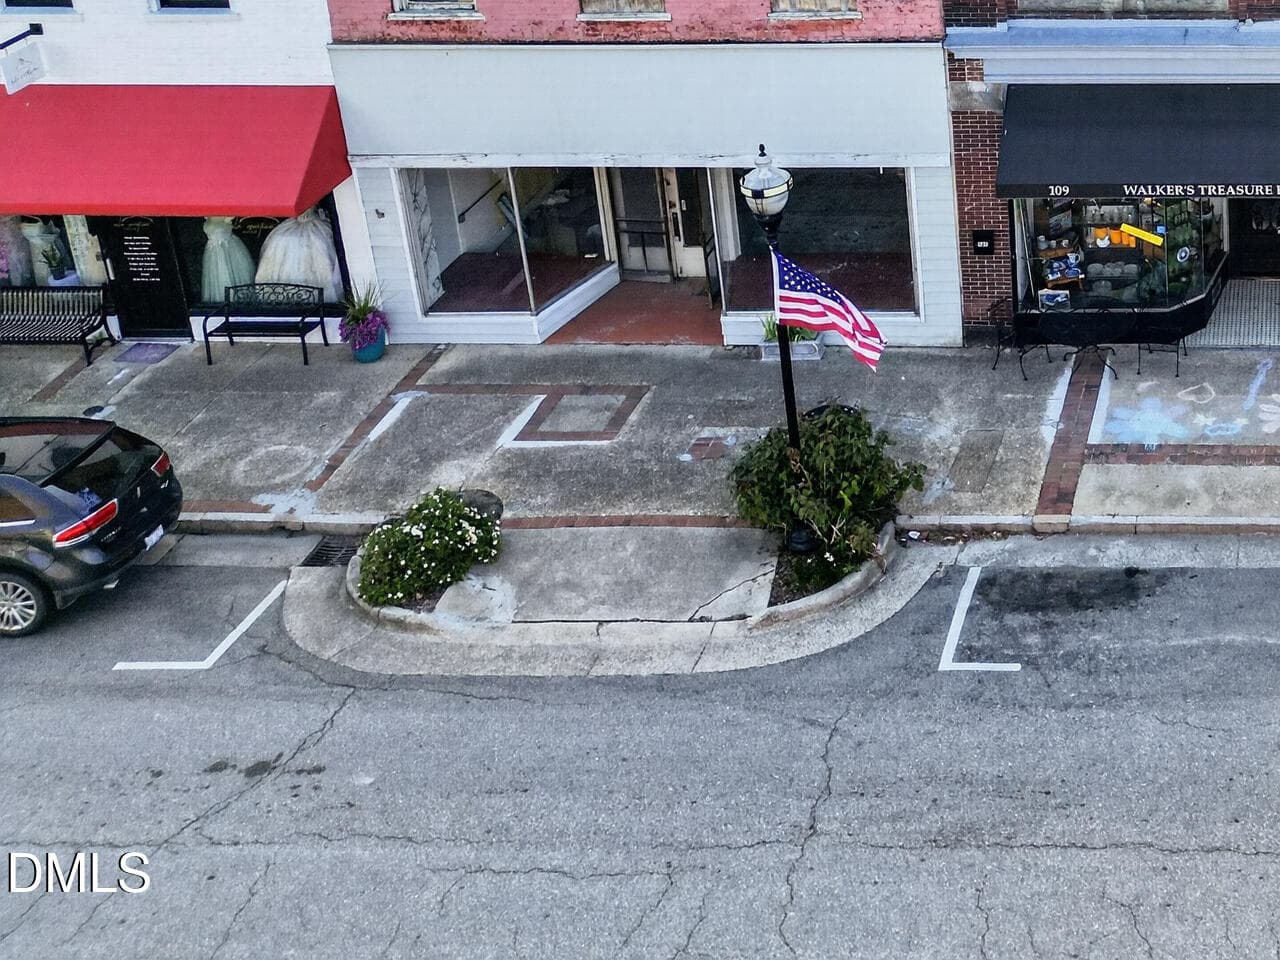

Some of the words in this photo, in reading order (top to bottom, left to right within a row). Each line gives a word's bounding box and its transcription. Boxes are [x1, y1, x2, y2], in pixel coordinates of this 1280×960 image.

[1048, 185, 1070, 196] 109
[1123, 185, 1195, 196] WALKER'S
[1198, 185, 1273, 196] TREASURE
